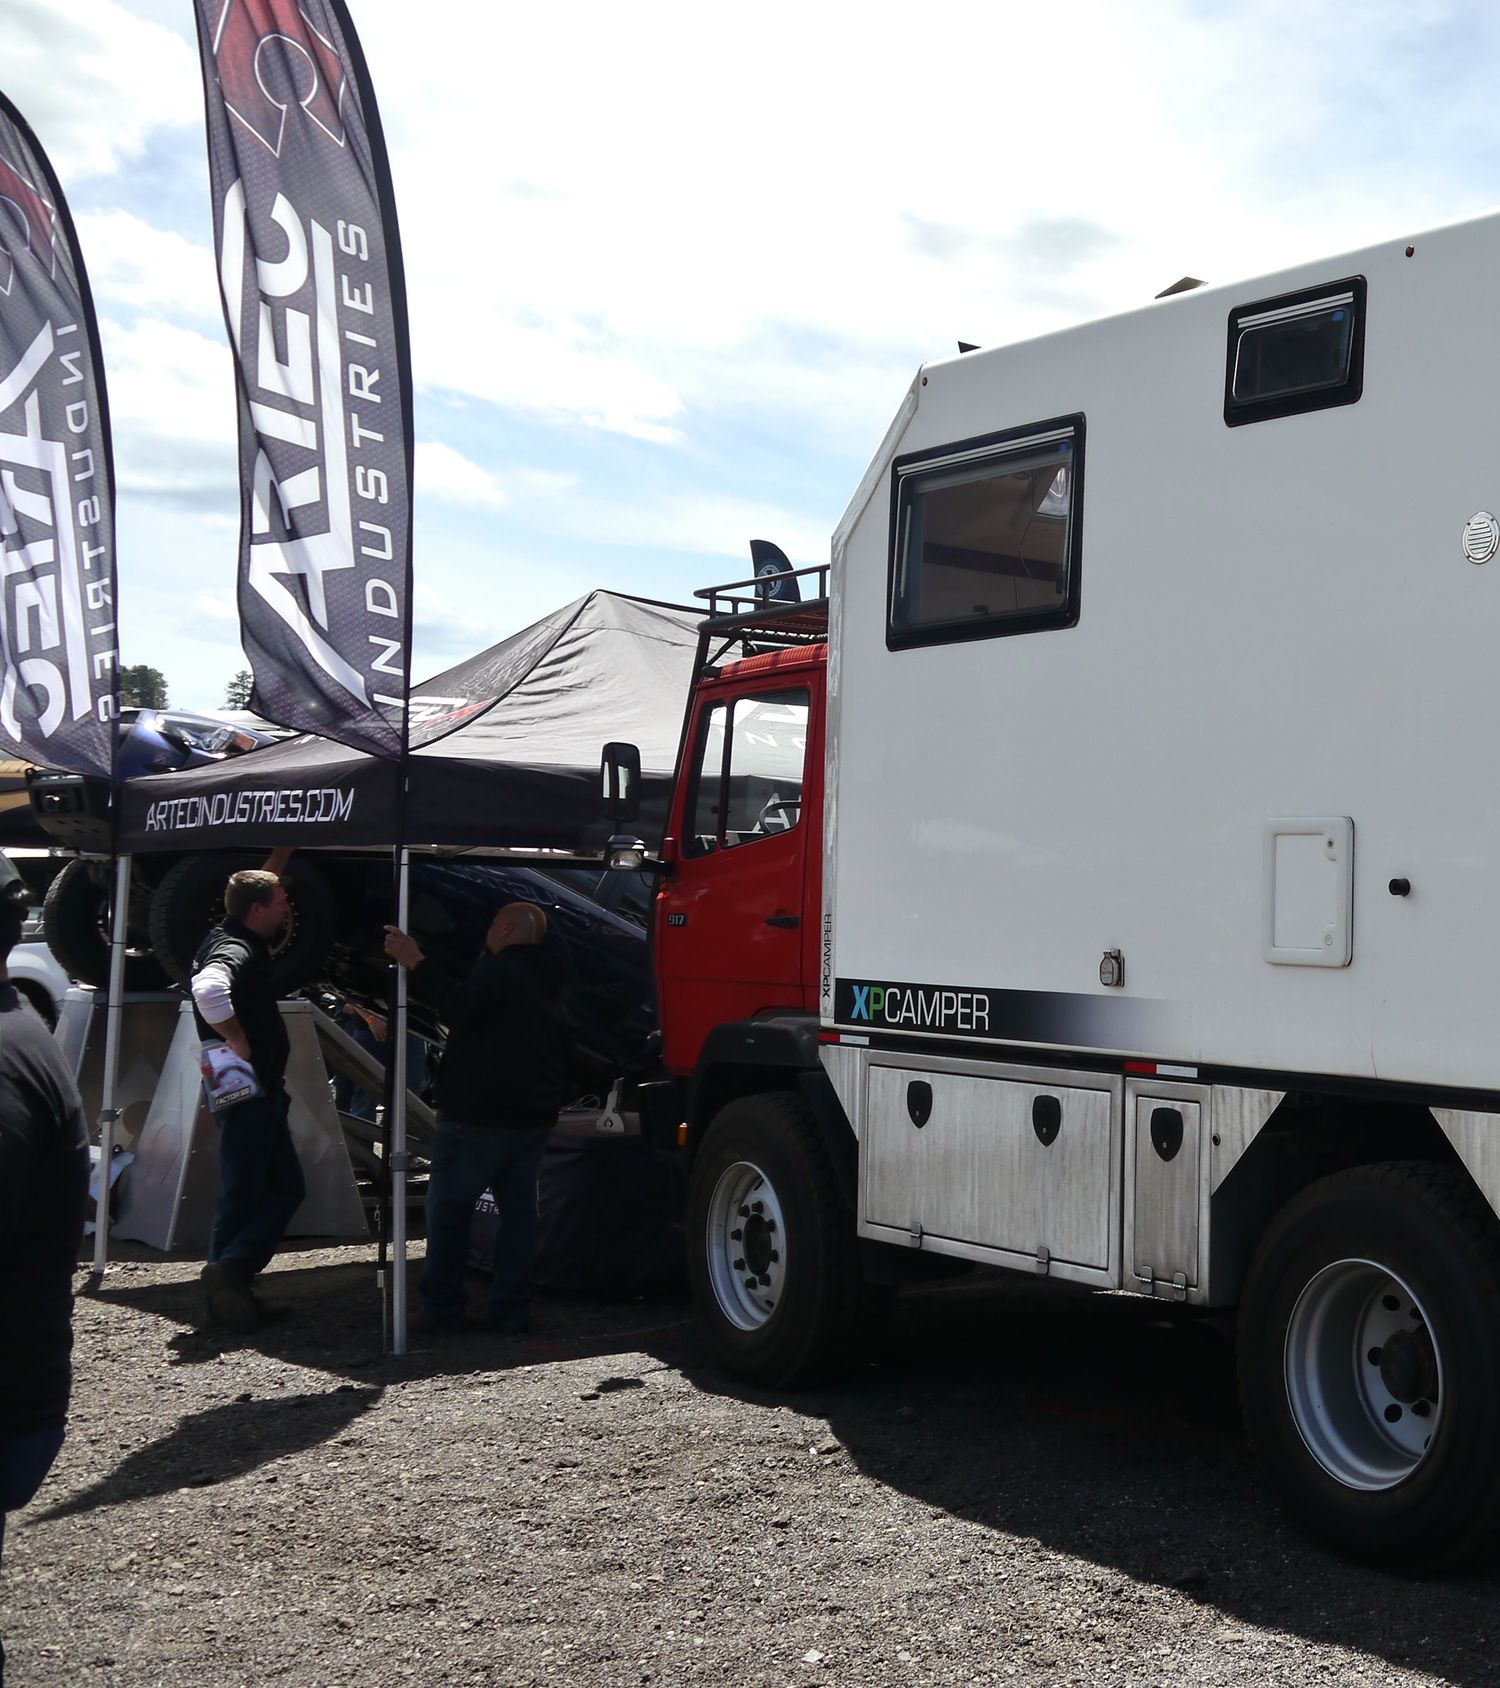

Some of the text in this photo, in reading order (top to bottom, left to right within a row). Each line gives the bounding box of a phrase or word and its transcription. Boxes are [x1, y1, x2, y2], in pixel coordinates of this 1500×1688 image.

[336, 219, 407, 708] INDUSTRIES
[145, 787, 354, 832] ARTECINDUSTRIES.COM
[668, 914, 685, 926] 917
[822, 913, 832, 998] XPCAMPER
[850, 985, 990, 1031] XPCAMPER
